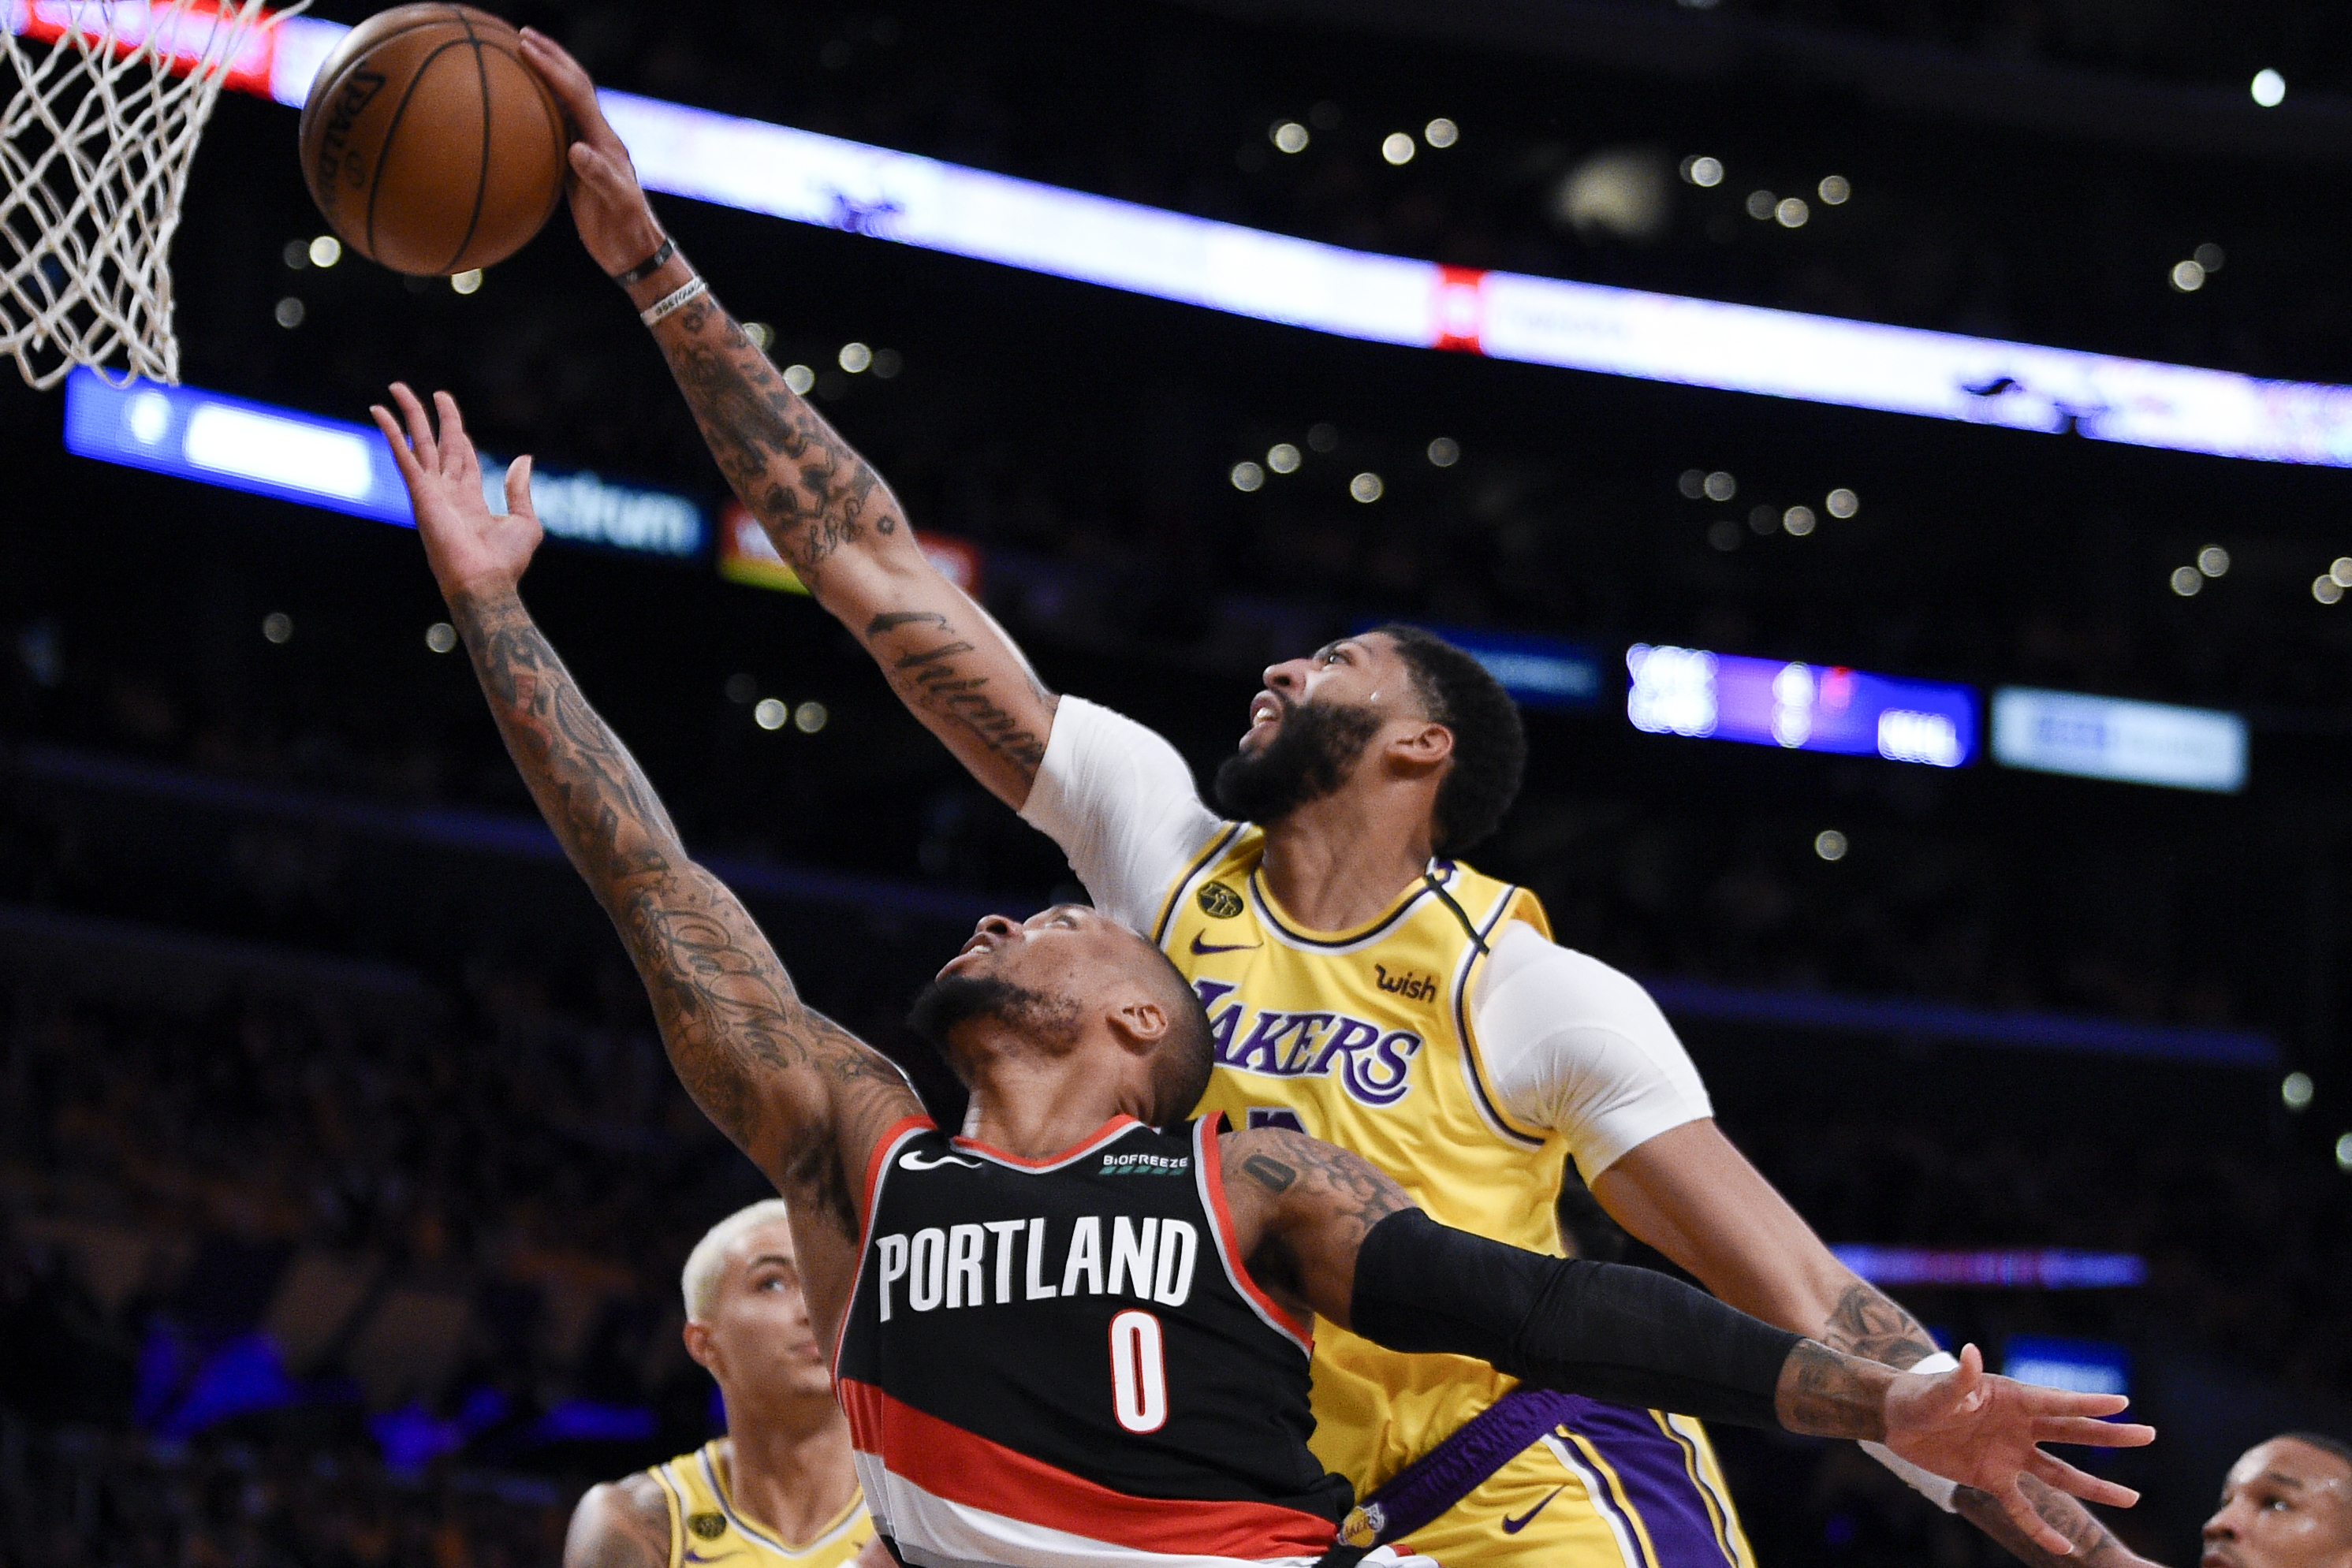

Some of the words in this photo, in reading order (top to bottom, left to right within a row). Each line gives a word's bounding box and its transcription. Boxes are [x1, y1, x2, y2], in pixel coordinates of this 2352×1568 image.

[1374, 963, 1437, 1004] wish
[875, 1216, 1199, 1323] PORTLAND
[1109, 1308, 1169, 1435] 0
